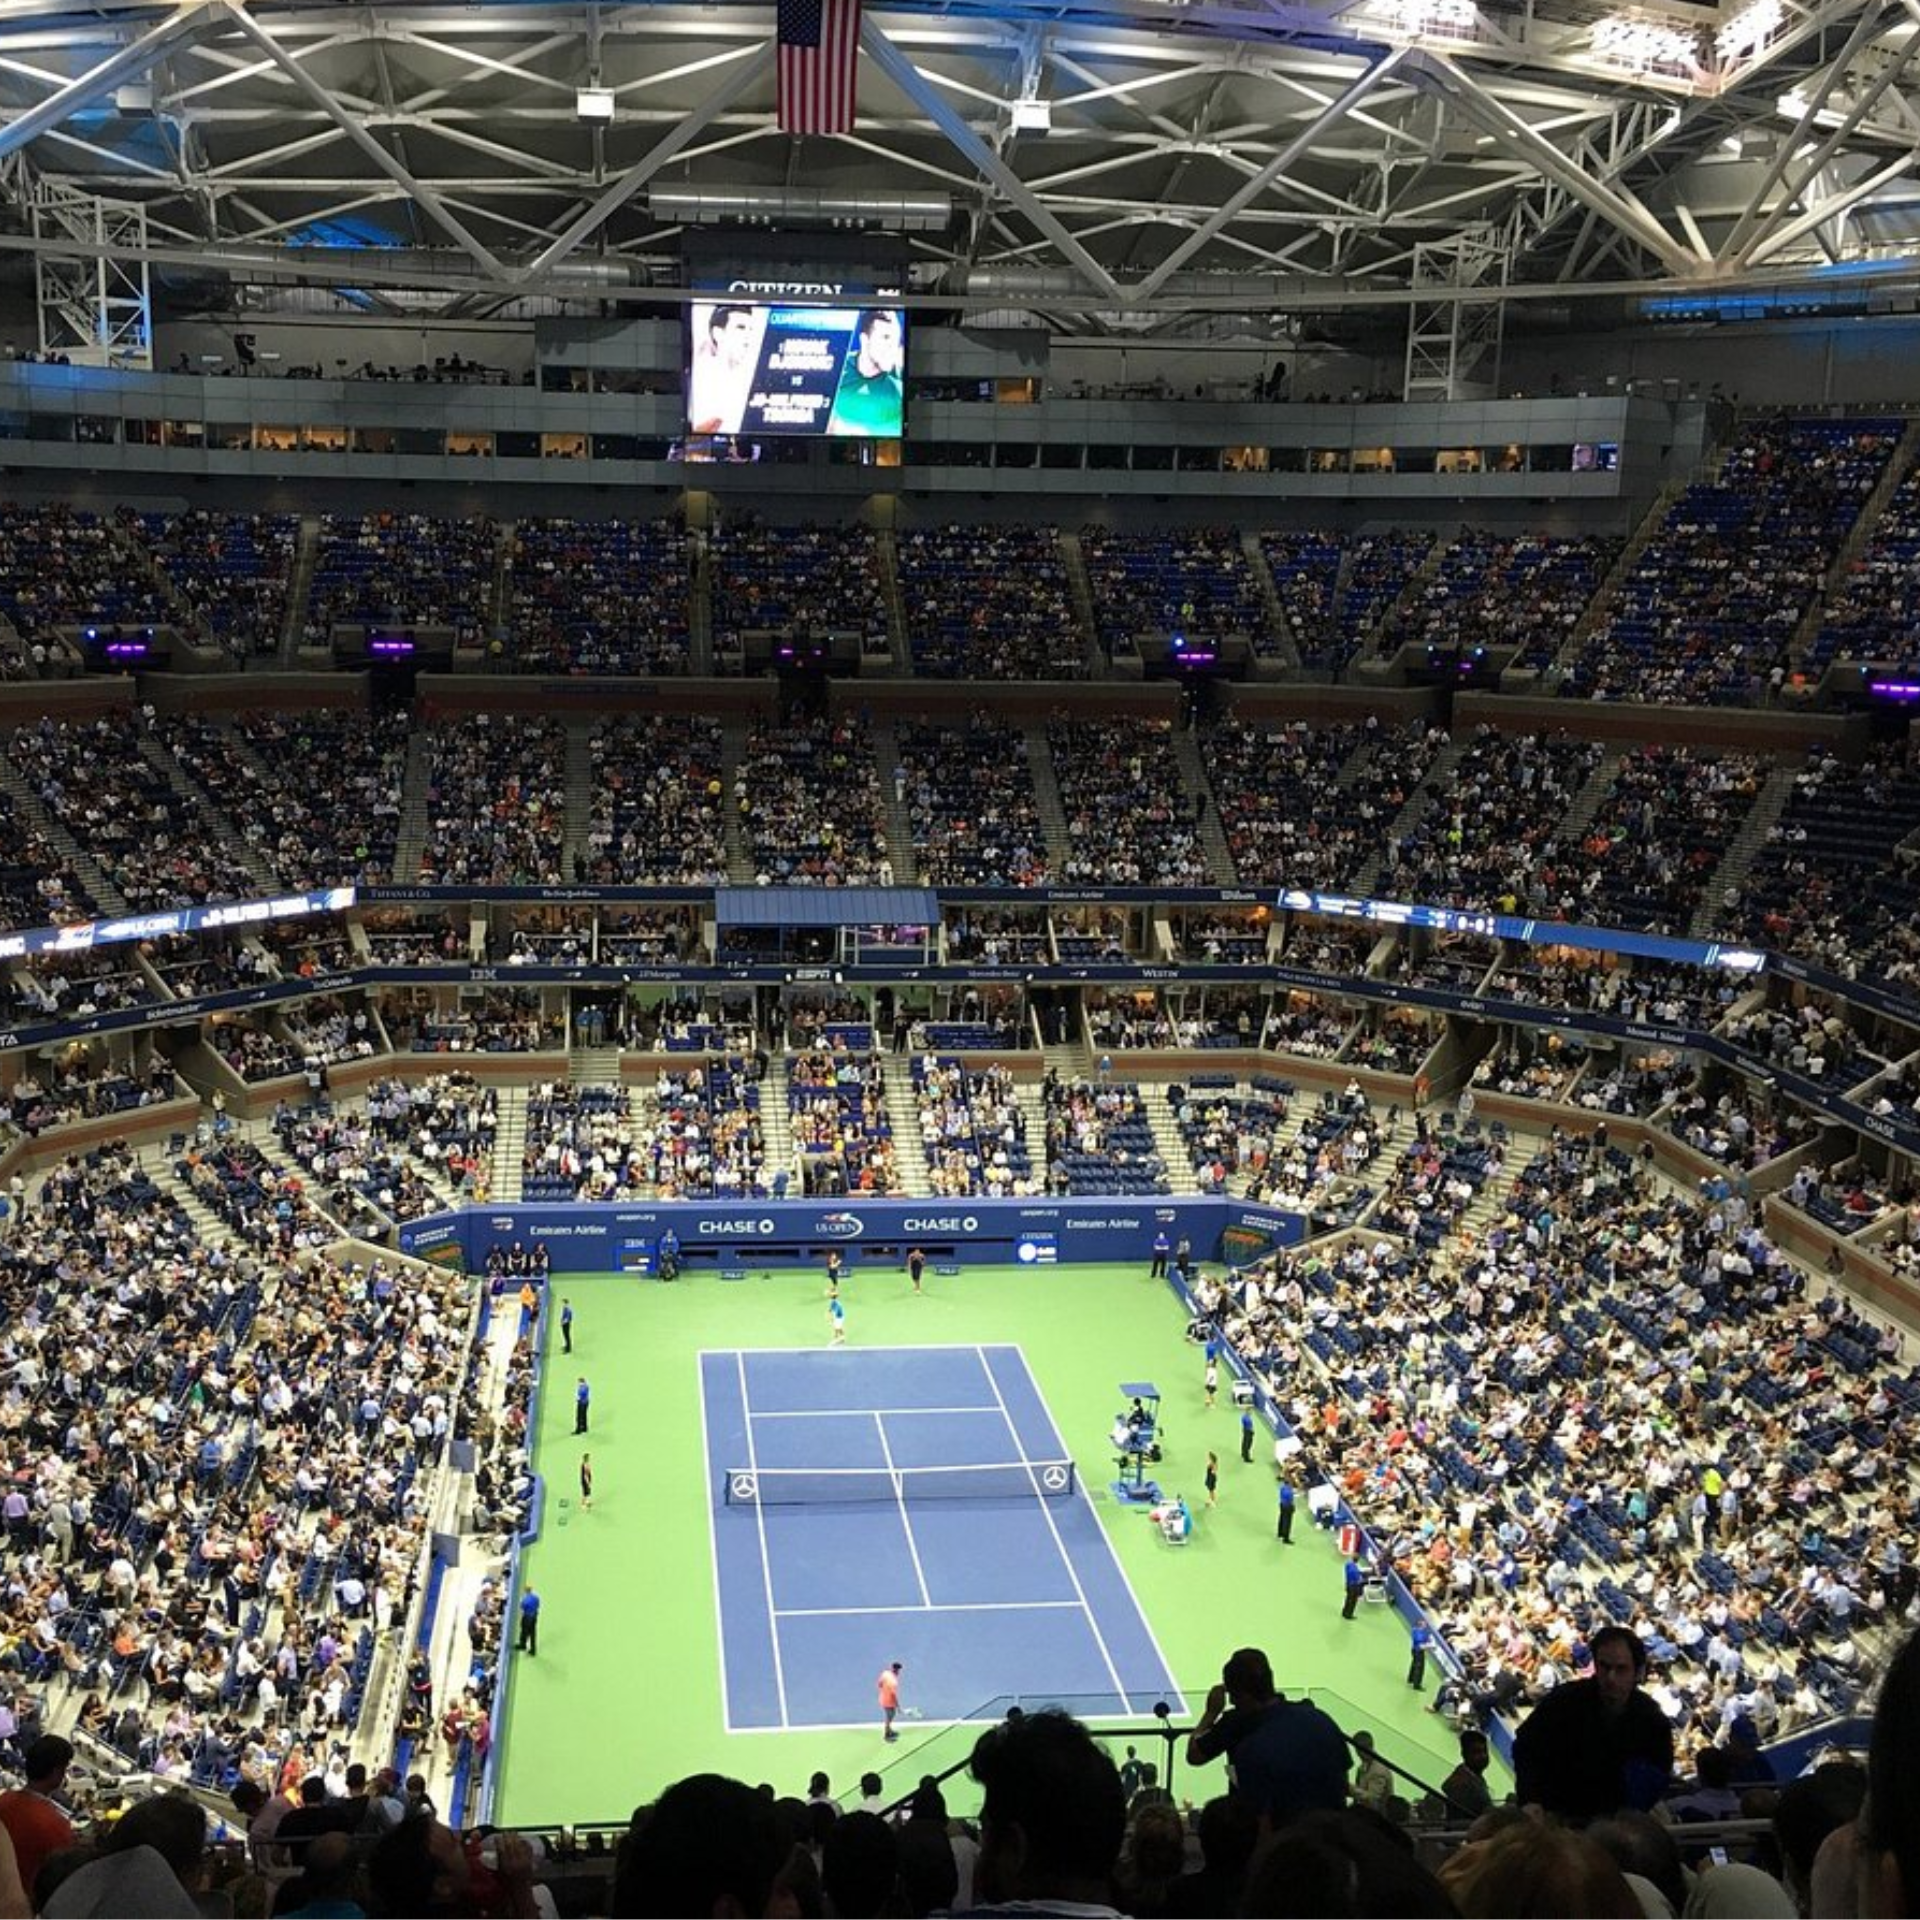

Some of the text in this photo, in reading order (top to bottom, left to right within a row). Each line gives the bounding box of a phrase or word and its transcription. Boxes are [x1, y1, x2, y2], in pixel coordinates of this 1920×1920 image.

[470, 969, 497, 980] IBM
[796, 968, 830, 980] ESPN
[1142, 968, 1179, 978] WESTIN
[699, 1220, 757, 1234] CHASE
[816, 1223, 856, 1233] US OPEN
[903, 1218, 960, 1231] CHASE
[1067, 1219, 1140, 1230] Emirates Airline
[530, 1225, 607, 1236] Emirates Airline
